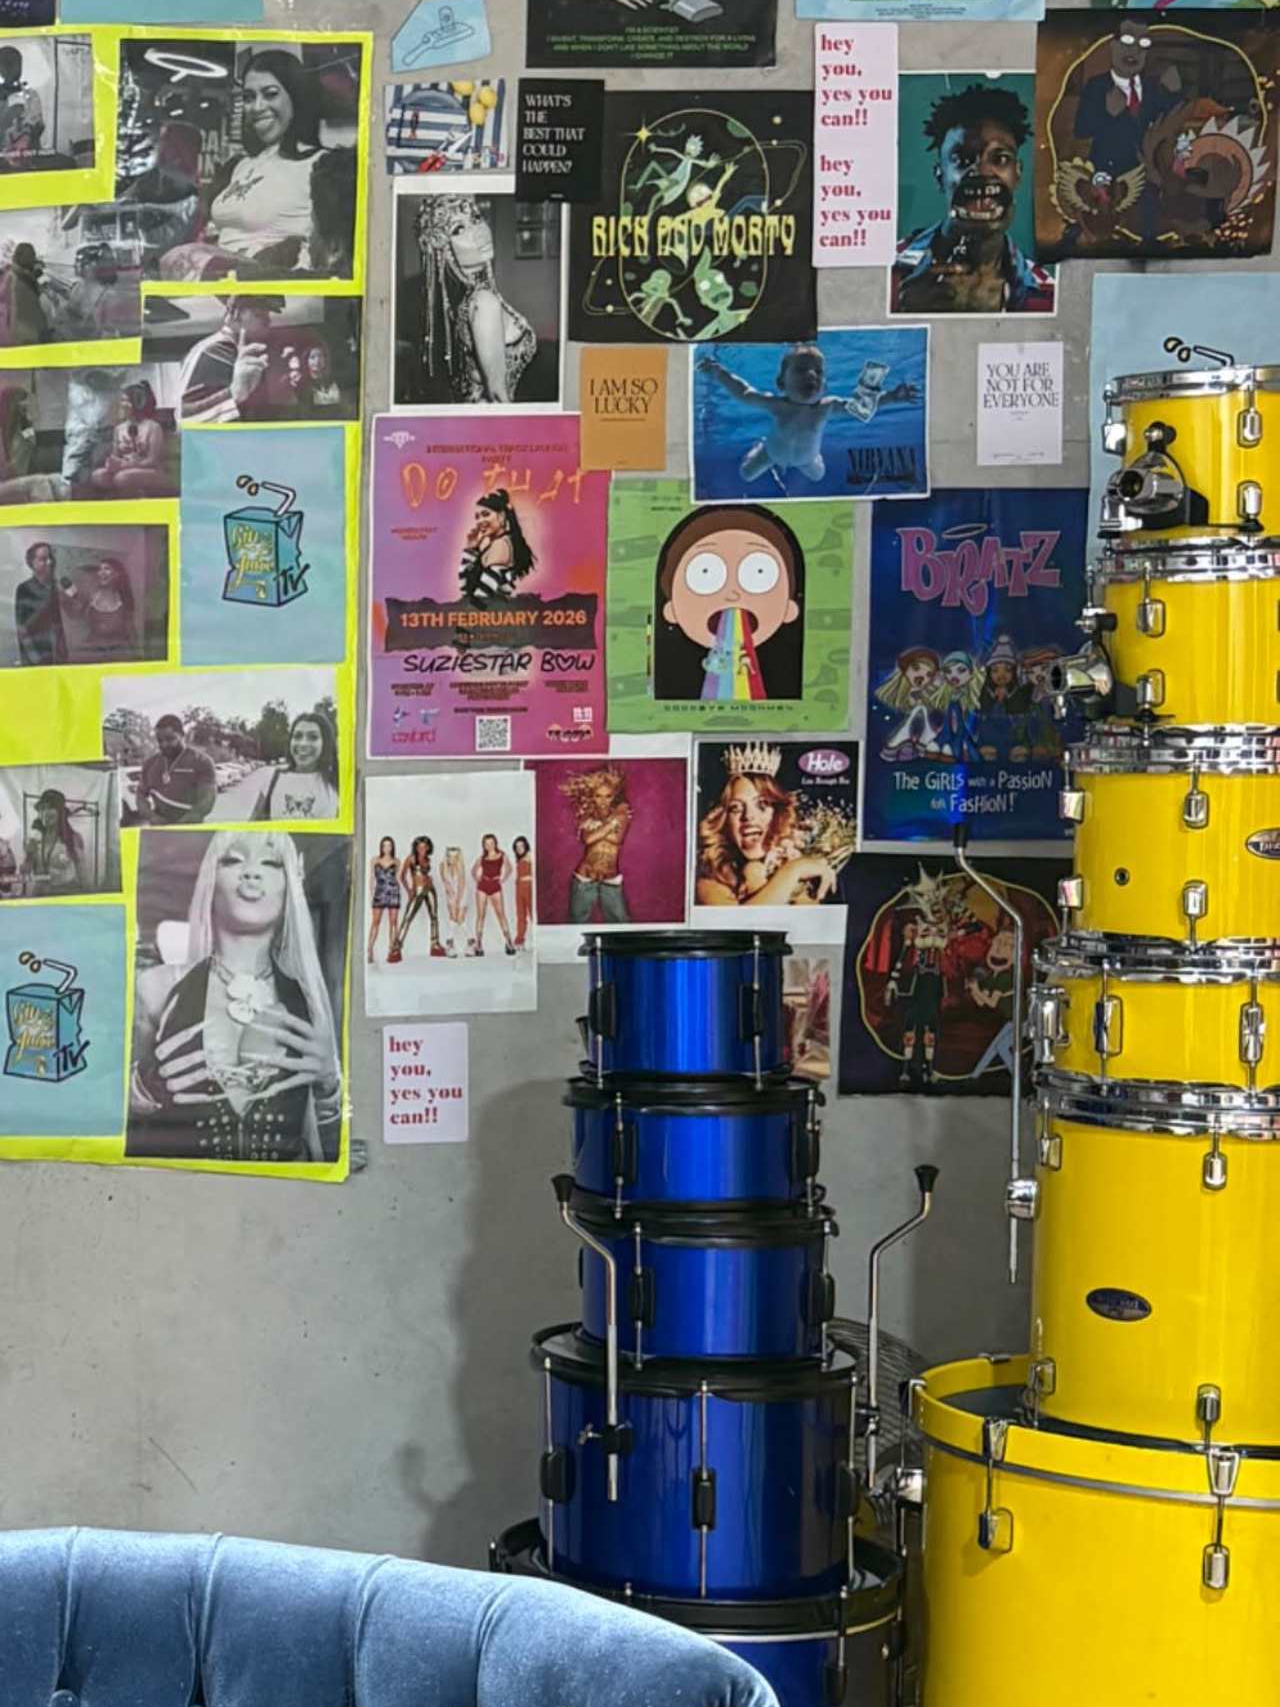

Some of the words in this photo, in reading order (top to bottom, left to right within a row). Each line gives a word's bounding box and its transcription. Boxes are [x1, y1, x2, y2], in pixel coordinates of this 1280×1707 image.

[821, 33, 855, 56] hey
[821, 63, 862, 81] you,
[525, 94, 572, 108] WHAT'S
[821, 88, 852, 105] yes
[858, 88, 893, 105] you
[524, 110, 549, 124] THE
[820, 108, 868, 127] can!!
[523, 127, 554, 142] BEST
[555, 127, 585, 142] THAT
[523, 143, 568, 158] COULD
[523, 160, 574, 175] HAPPEN?
[820, 154, 854, 176] hey
[820, 185, 862, 201] you,
[820, 209, 851, 226] yes
[857, 208, 892, 226] you
[592, 215, 649, 257] RICK
[712, 214, 796, 258] MORTY
[819, 228, 867, 247] can!!
[986, 363, 1019, 379] YOU
[1021, 363, 1051, 379] ARE
[589, 378, 596, 396] I
[598, 378, 627, 396] AM
[631, 377, 658, 396] SO
[986, 378, 1019, 393] NOT
[1024, 378, 1054, 393] FOR
[594, 396, 654, 415] LUCKY
[983, 392, 1060, 409] EVERYONE
[847, 446, 917, 475] NIRVANA
[273, 563, 310, 596] TV
[895, 526, 1062, 615] BRATZ
[399, 613, 443, 628] 13TH
[447, 611, 539, 627] FEBRUARY
[543, 609, 588, 626] 2026
[403, 653, 533, 674] SUZIESTAR
[807, 751, 843, 772] Hole
[893, 772, 920, 791] The
[389, 1036, 423, 1055] hey
[52, 1040, 90, 1071] TV
[390, 1062, 431, 1078] you,
[390, 1086, 421, 1102] yes
[427, 1086, 463, 1102] you
[390, 1108, 439, 1125] can!!
